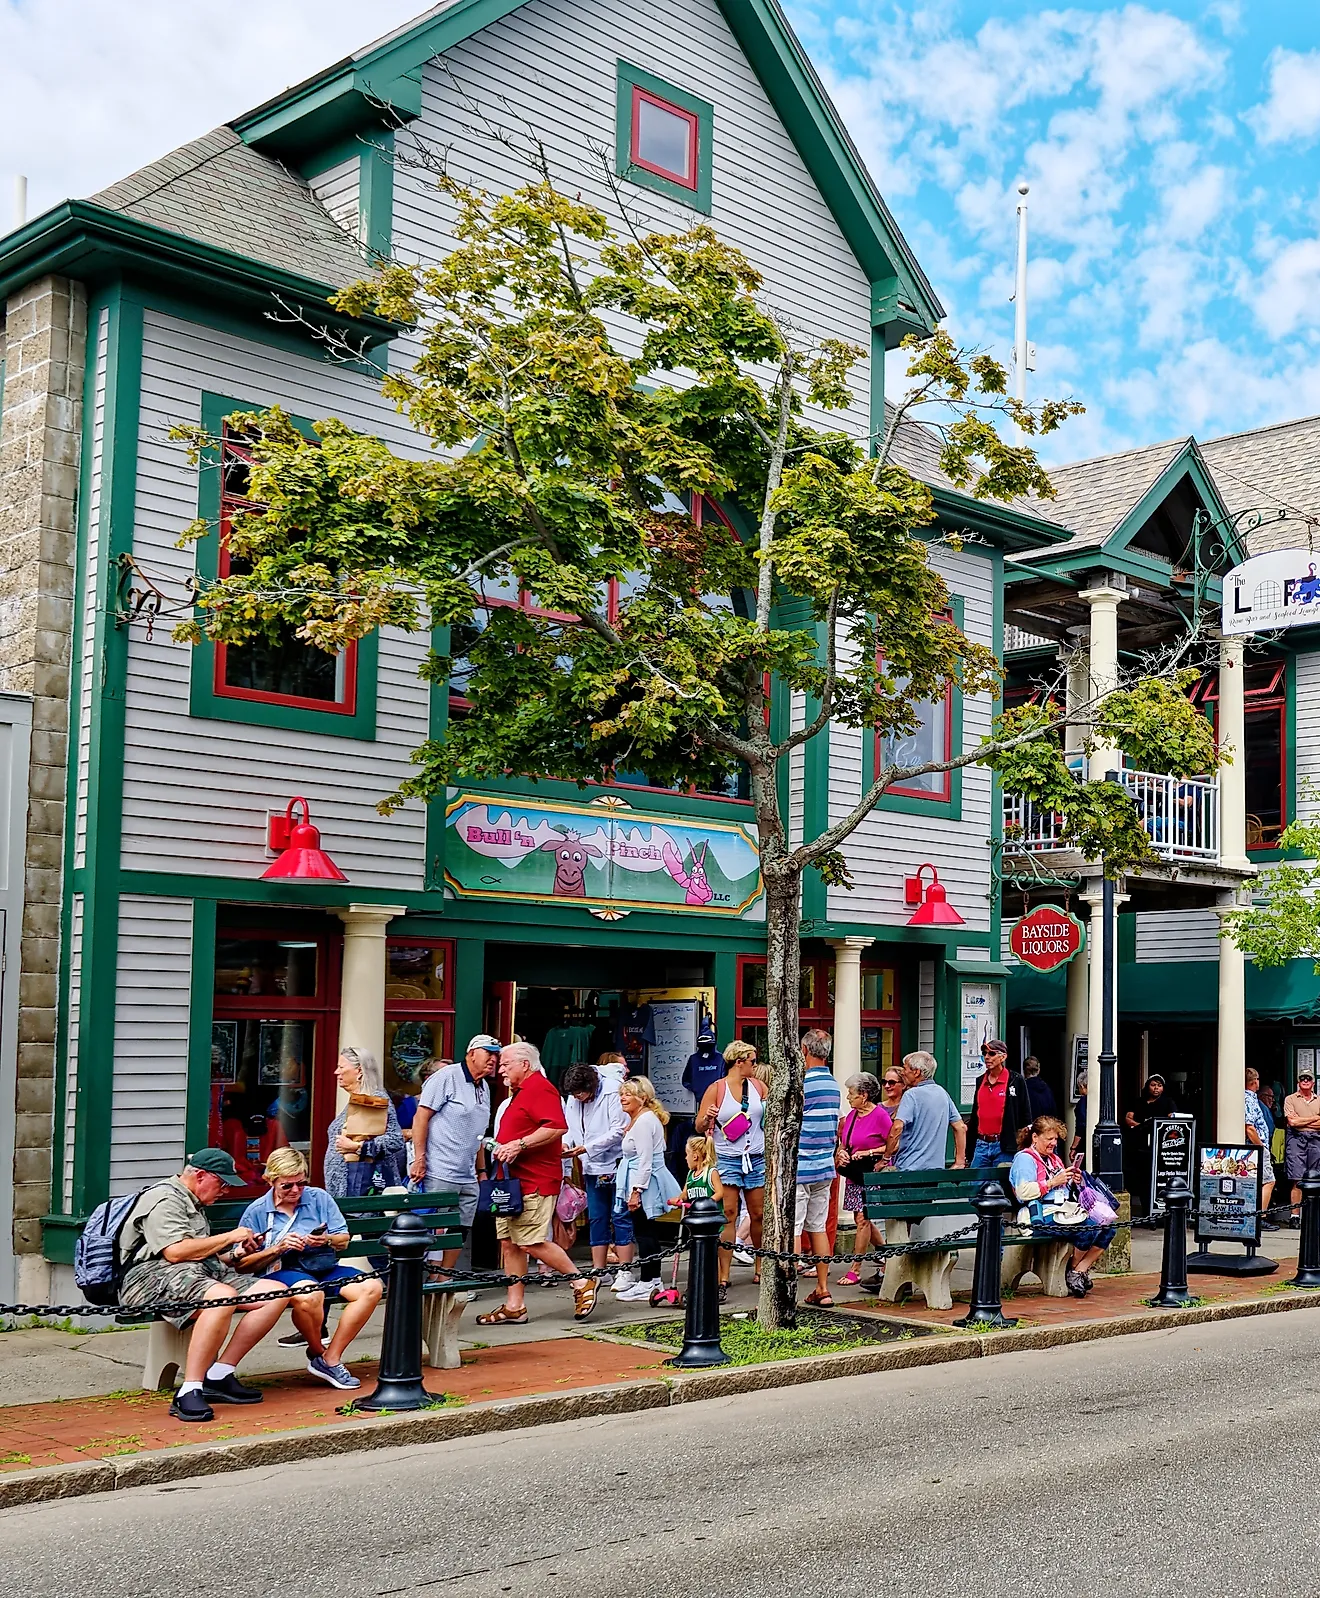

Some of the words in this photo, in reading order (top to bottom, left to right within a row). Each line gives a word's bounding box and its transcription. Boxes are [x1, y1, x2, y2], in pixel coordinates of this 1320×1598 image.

[1229, 574, 1246, 587] The
[1259, 612, 1272, 621] and
[466, 825, 512, 845] Bull
[605, 840, 663, 861] Pinch
[713, 893, 731, 903] LLC
[1022, 923, 1070, 939] BAYSIDE
[1022, 939, 1070, 956] LIQUORS
